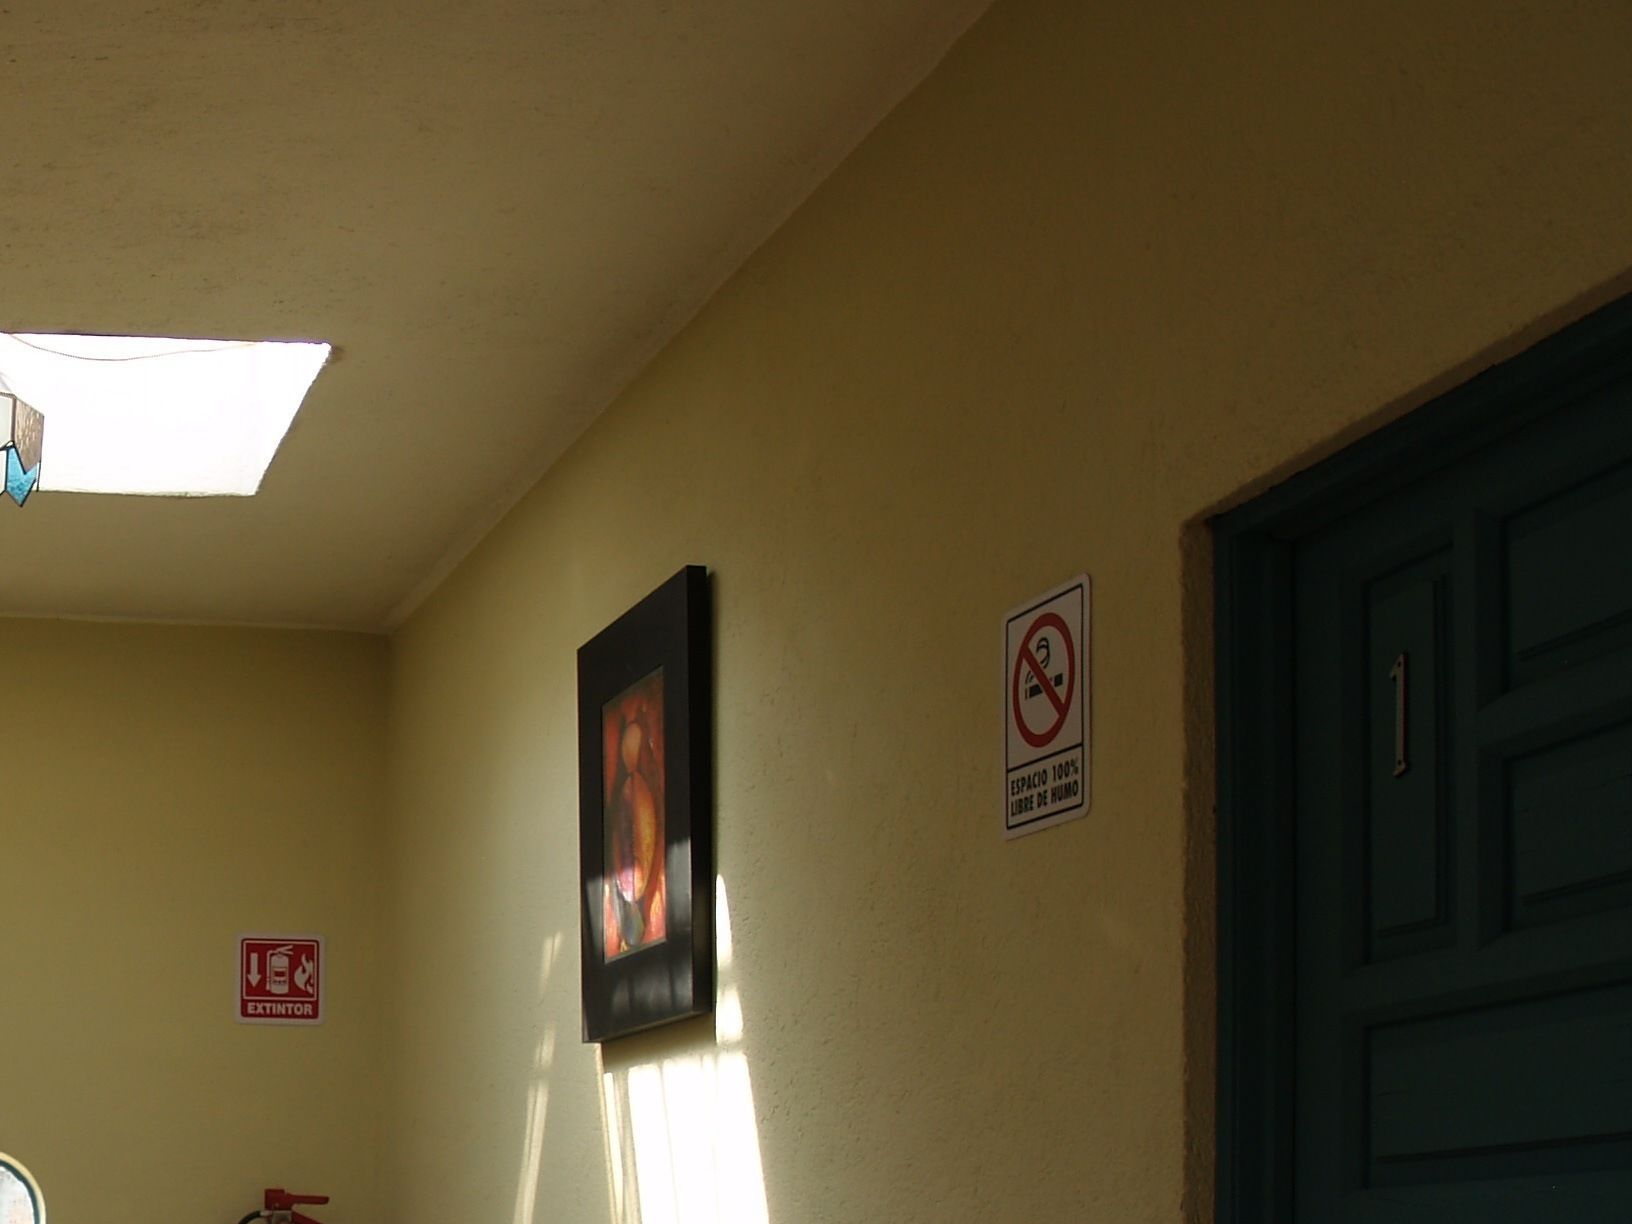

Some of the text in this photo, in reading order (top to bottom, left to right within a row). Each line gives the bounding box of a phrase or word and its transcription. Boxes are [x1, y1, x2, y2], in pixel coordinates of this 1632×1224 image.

[1011, 758, 1079, 796] ESPACIO 100%
[1011, 780, 1079, 816] LIBRE DE HUMO
[247, 1002, 313, 1016] EXTINTOR
